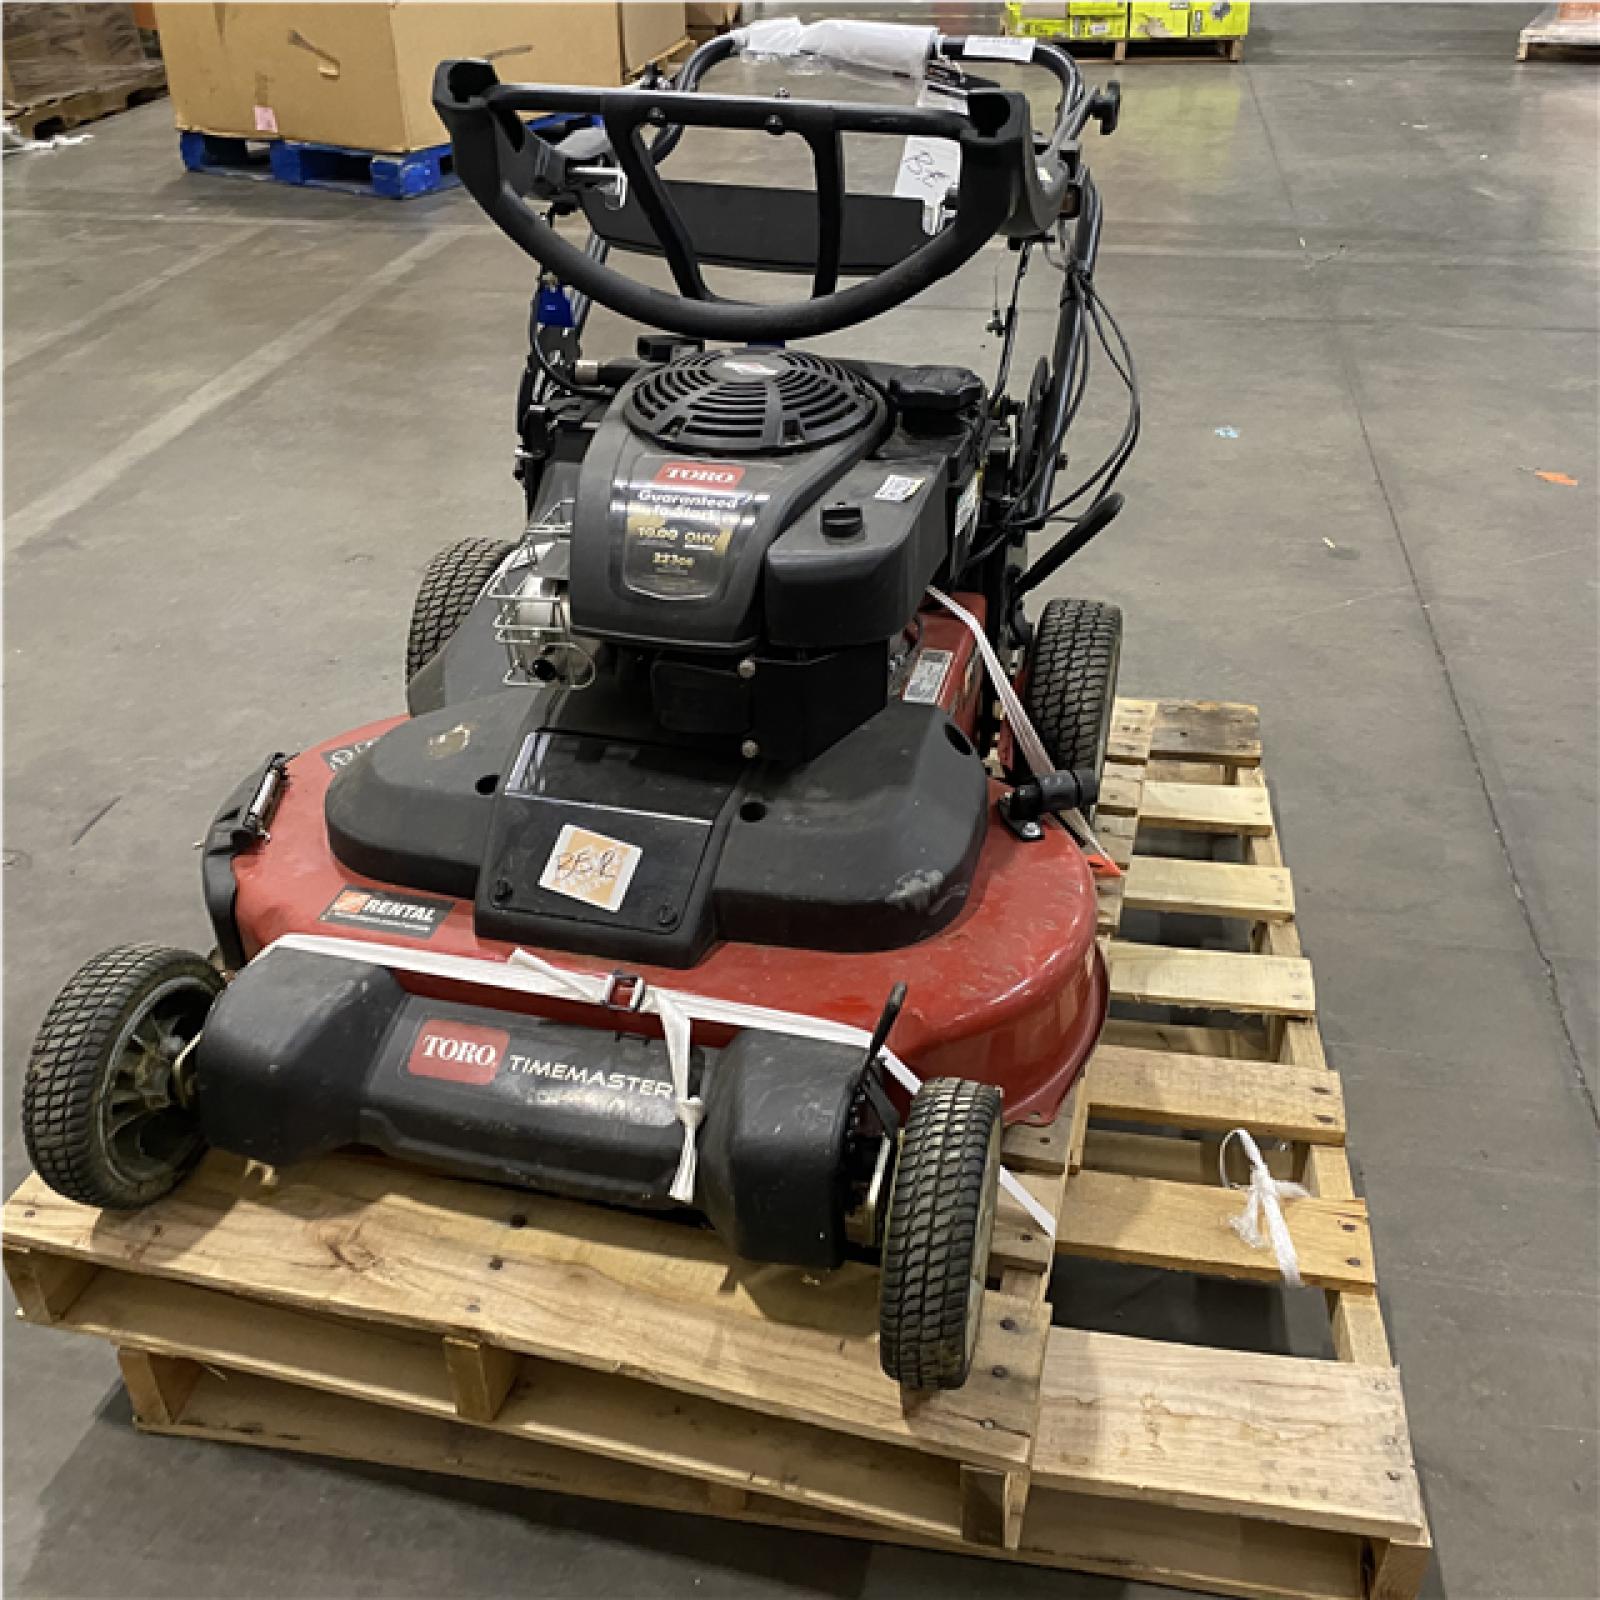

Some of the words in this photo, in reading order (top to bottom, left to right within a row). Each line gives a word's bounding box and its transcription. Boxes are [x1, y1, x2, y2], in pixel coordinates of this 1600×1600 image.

[667, 467, 735, 481] TORO
[361, 898, 437, 922] RENTAL
[422, 1034, 498, 1067] TORO
[509, 1054, 674, 1101] TIMEMASTER
